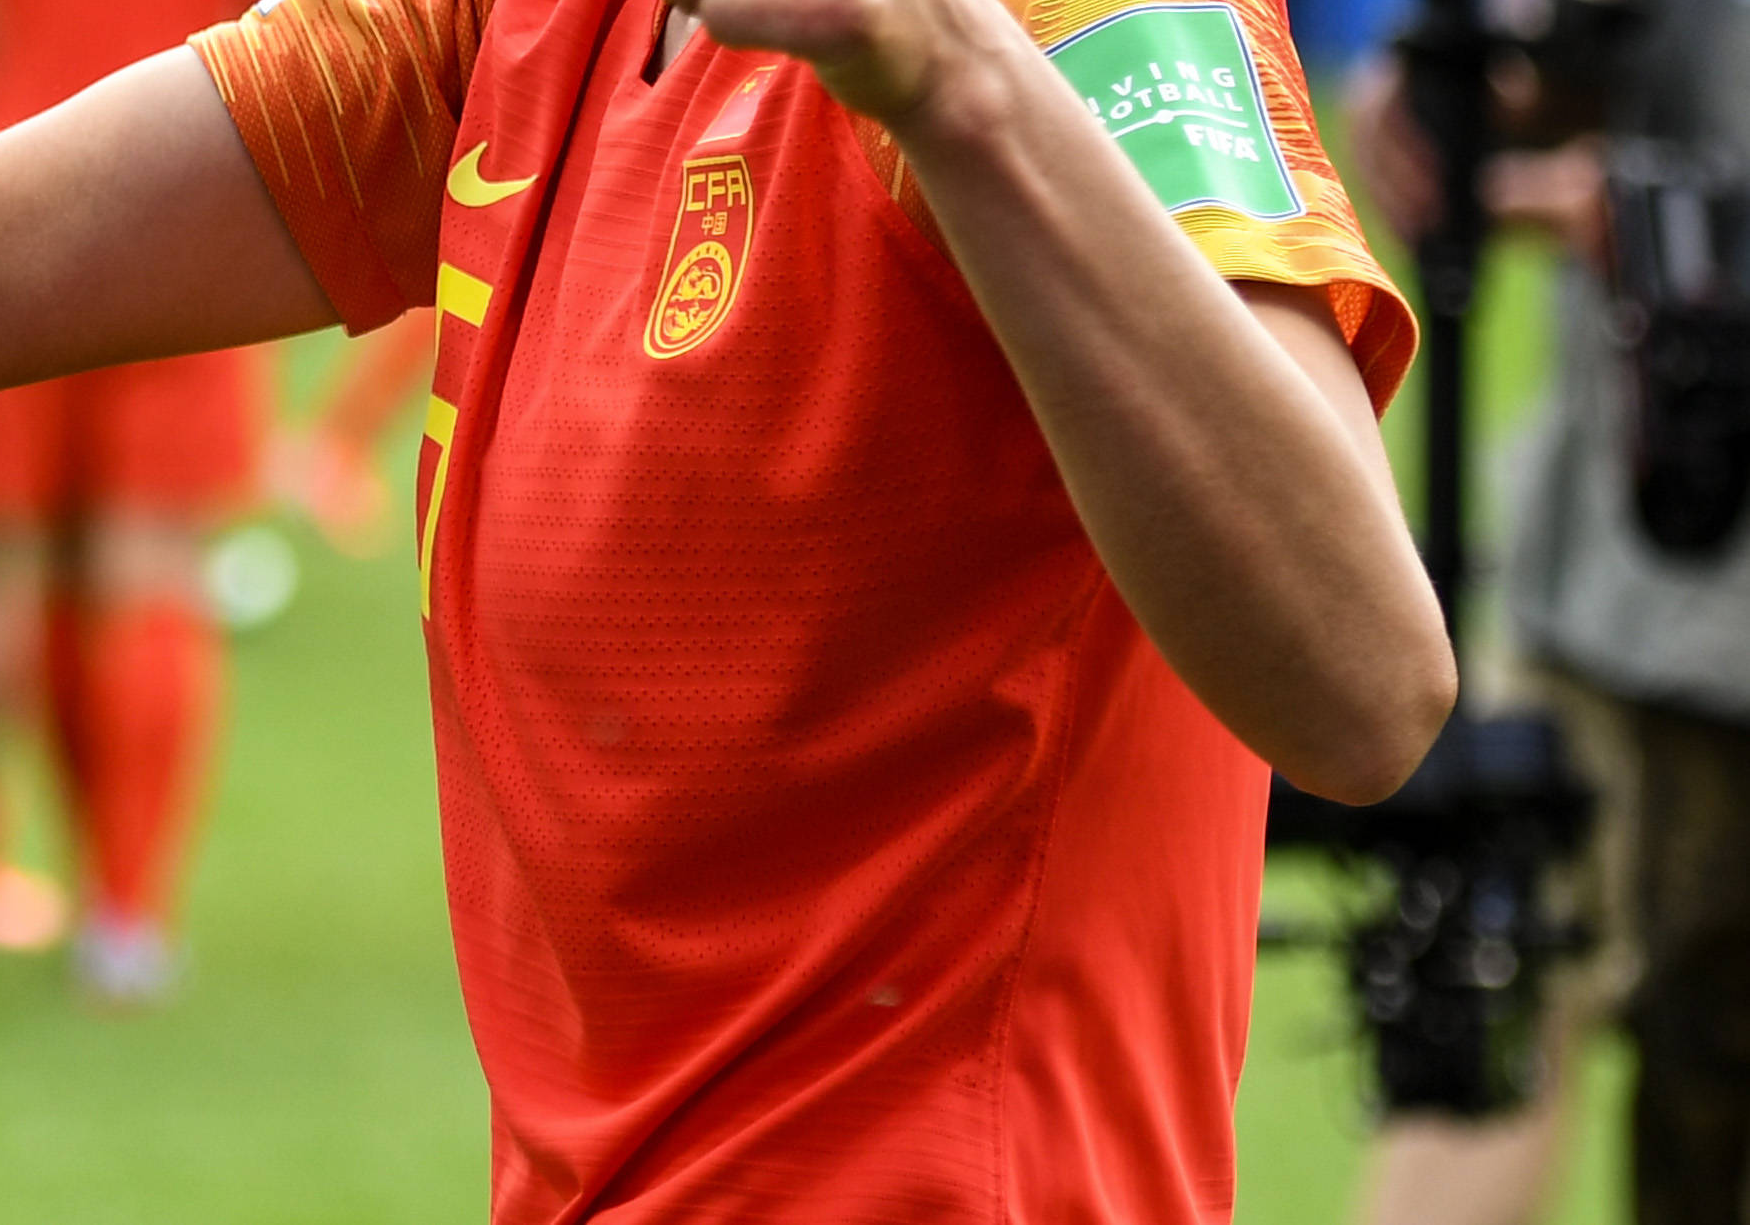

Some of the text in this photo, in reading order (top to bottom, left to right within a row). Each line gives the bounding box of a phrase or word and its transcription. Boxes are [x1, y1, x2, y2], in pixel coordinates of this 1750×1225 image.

[1087, 61, 1236, 115] IVING
[1096, 83, 1243, 123] OTBALL
[1182, 123, 1261, 163] FIFA
[685, 169, 746, 212] CFA
[700, 211, 729, 236] 中国
